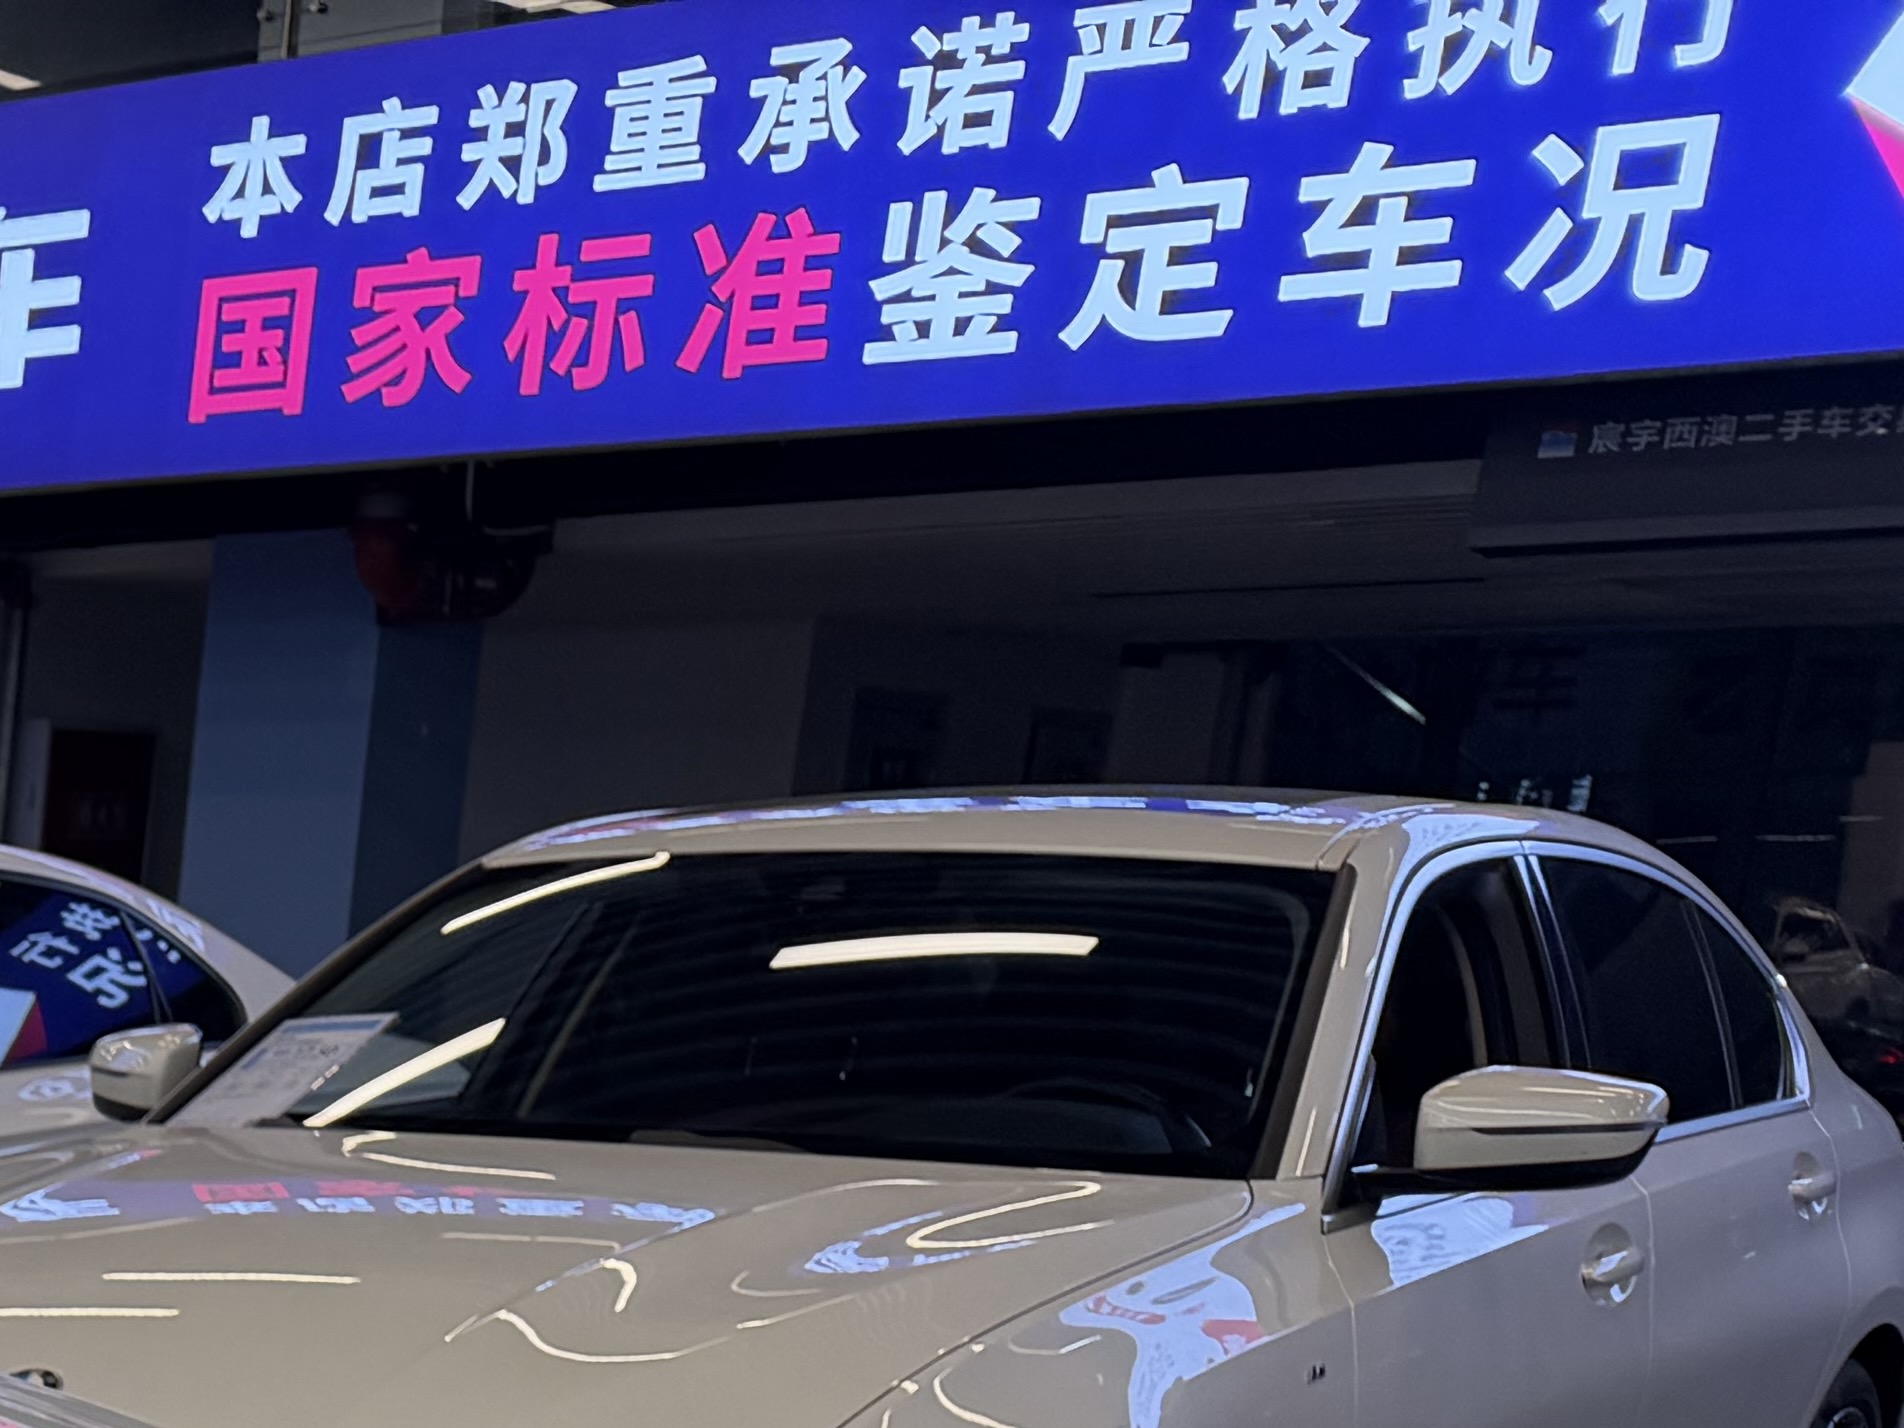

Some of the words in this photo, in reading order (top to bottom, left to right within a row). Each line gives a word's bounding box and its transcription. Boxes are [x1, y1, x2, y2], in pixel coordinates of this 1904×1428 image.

[188, 112, 1722, 425] 国家标准鉴定车况
[1588, 403, 1904, 455] 宸宇西澳二手车交
